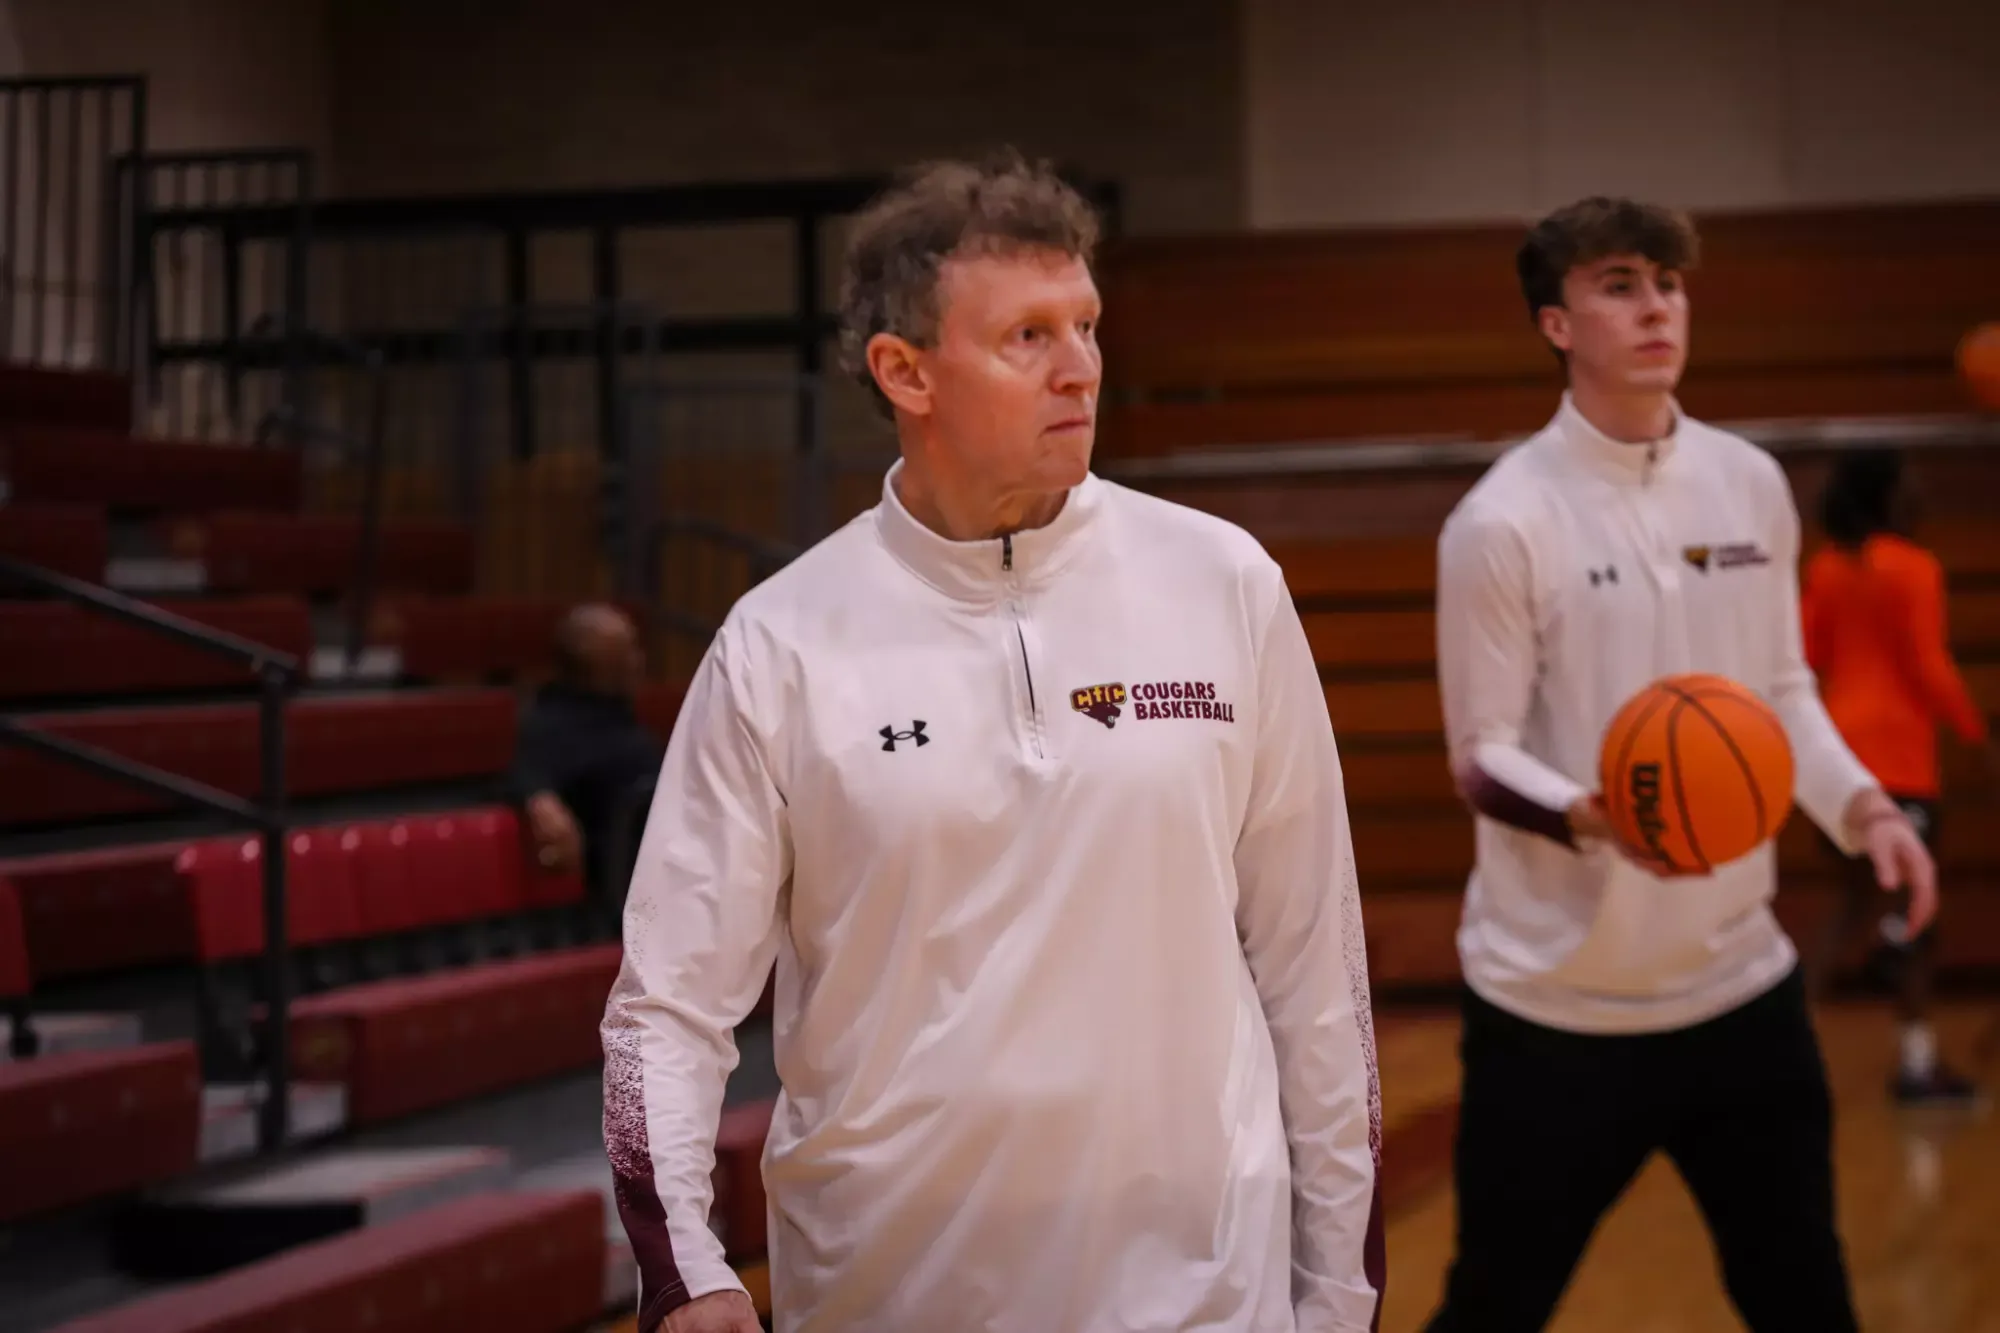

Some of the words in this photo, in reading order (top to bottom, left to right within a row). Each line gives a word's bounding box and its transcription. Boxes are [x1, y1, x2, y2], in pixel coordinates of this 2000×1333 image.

[1131, 682, 1216, 701] COUGARS
[1134, 701, 1235, 723] BASKETBALL
[1631, 763, 1678, 871] Wil
